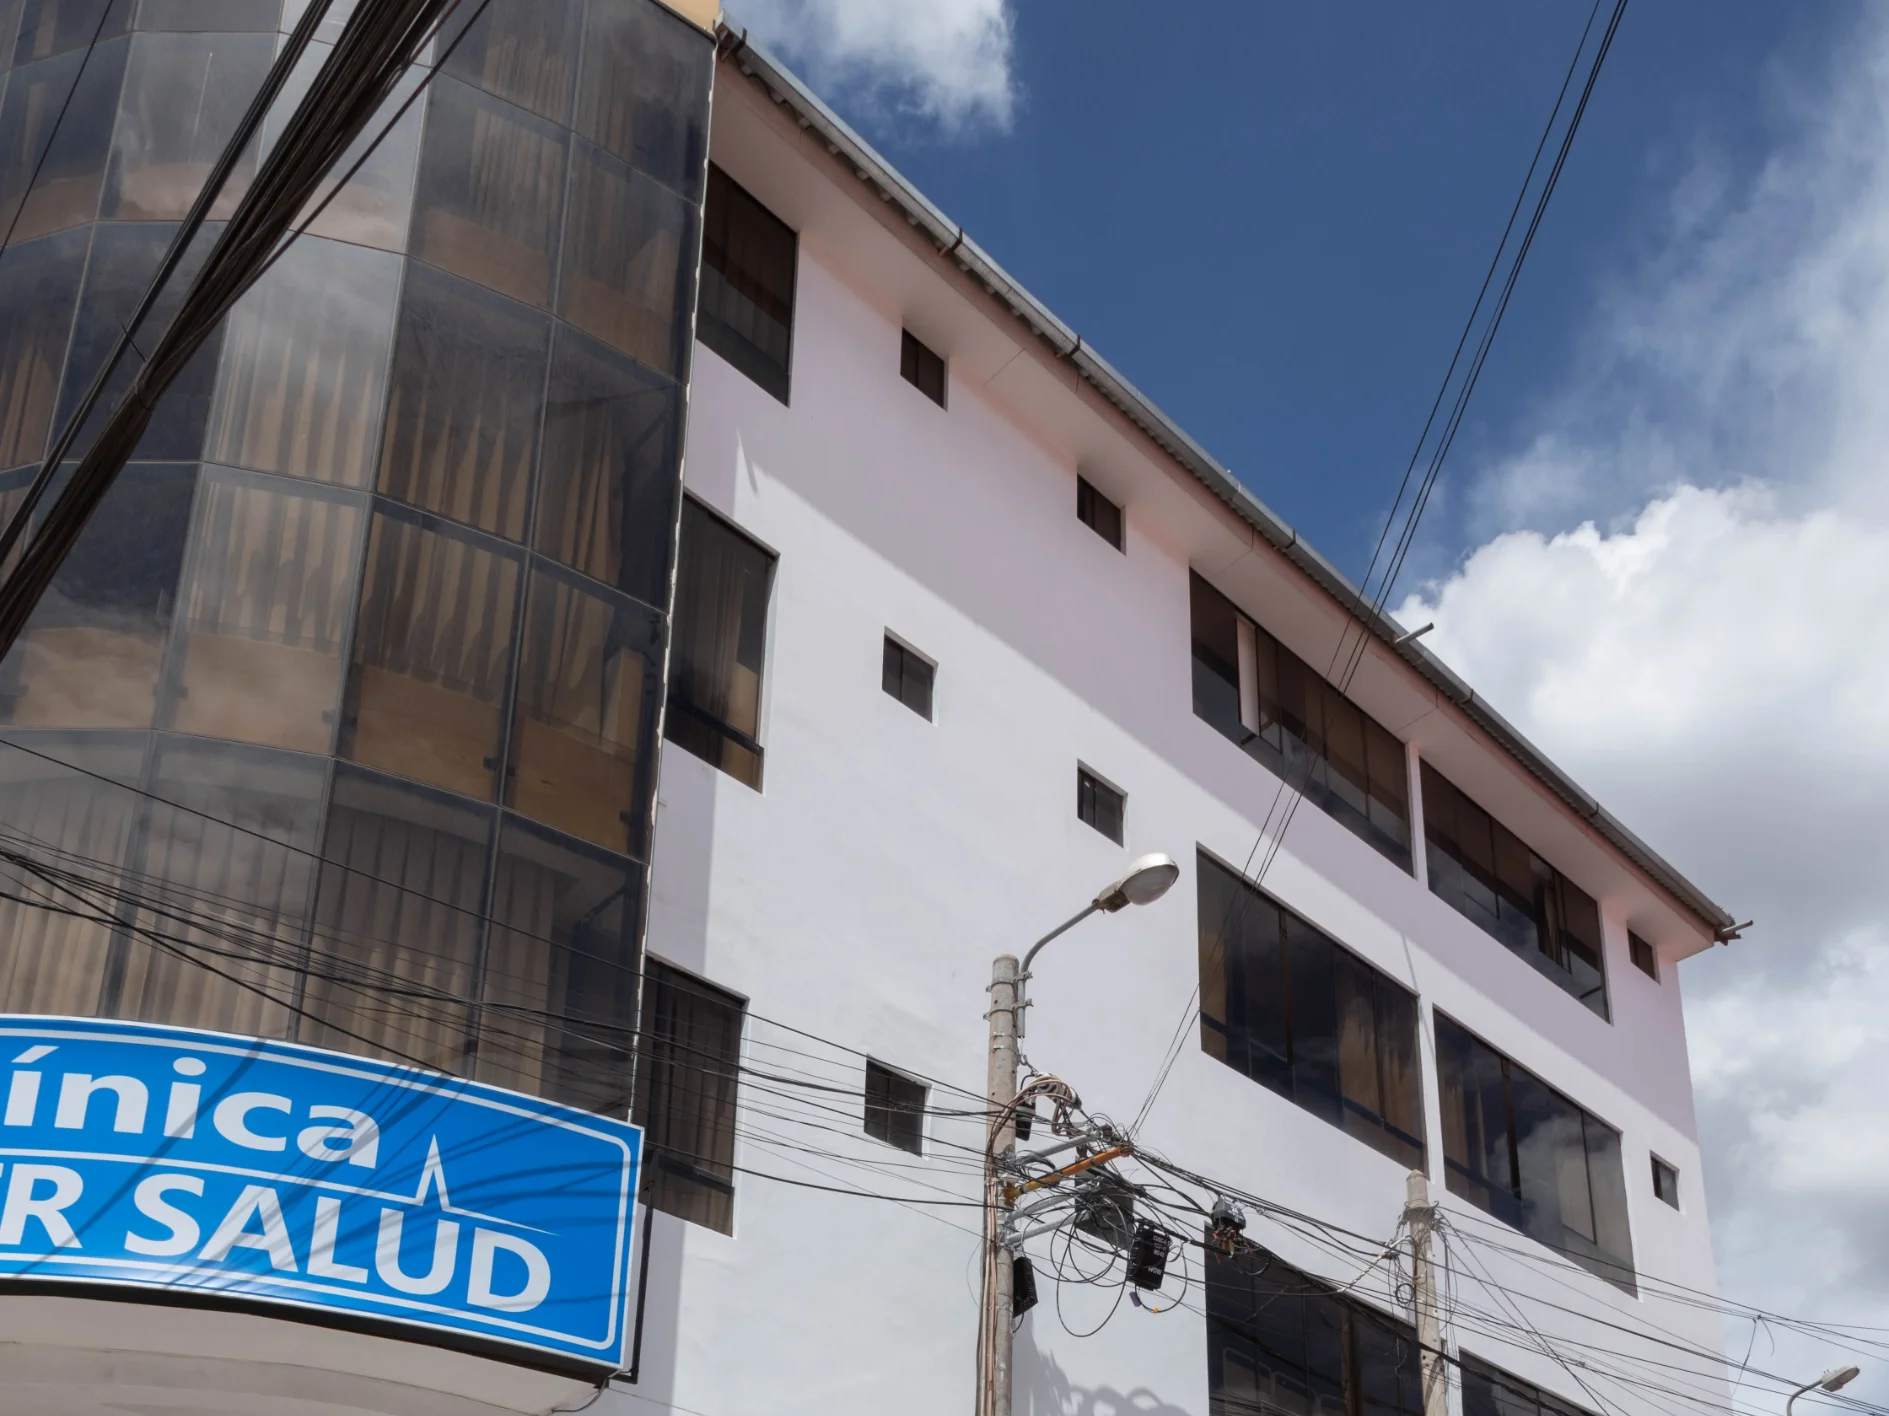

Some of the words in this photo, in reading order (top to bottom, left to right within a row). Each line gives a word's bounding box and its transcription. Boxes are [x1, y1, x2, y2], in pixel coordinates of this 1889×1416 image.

[4, 1045, 381, 1169] ínica
[0, 1163, 84, 1249] R
[125, 1174, 551, 1313] SALUD
